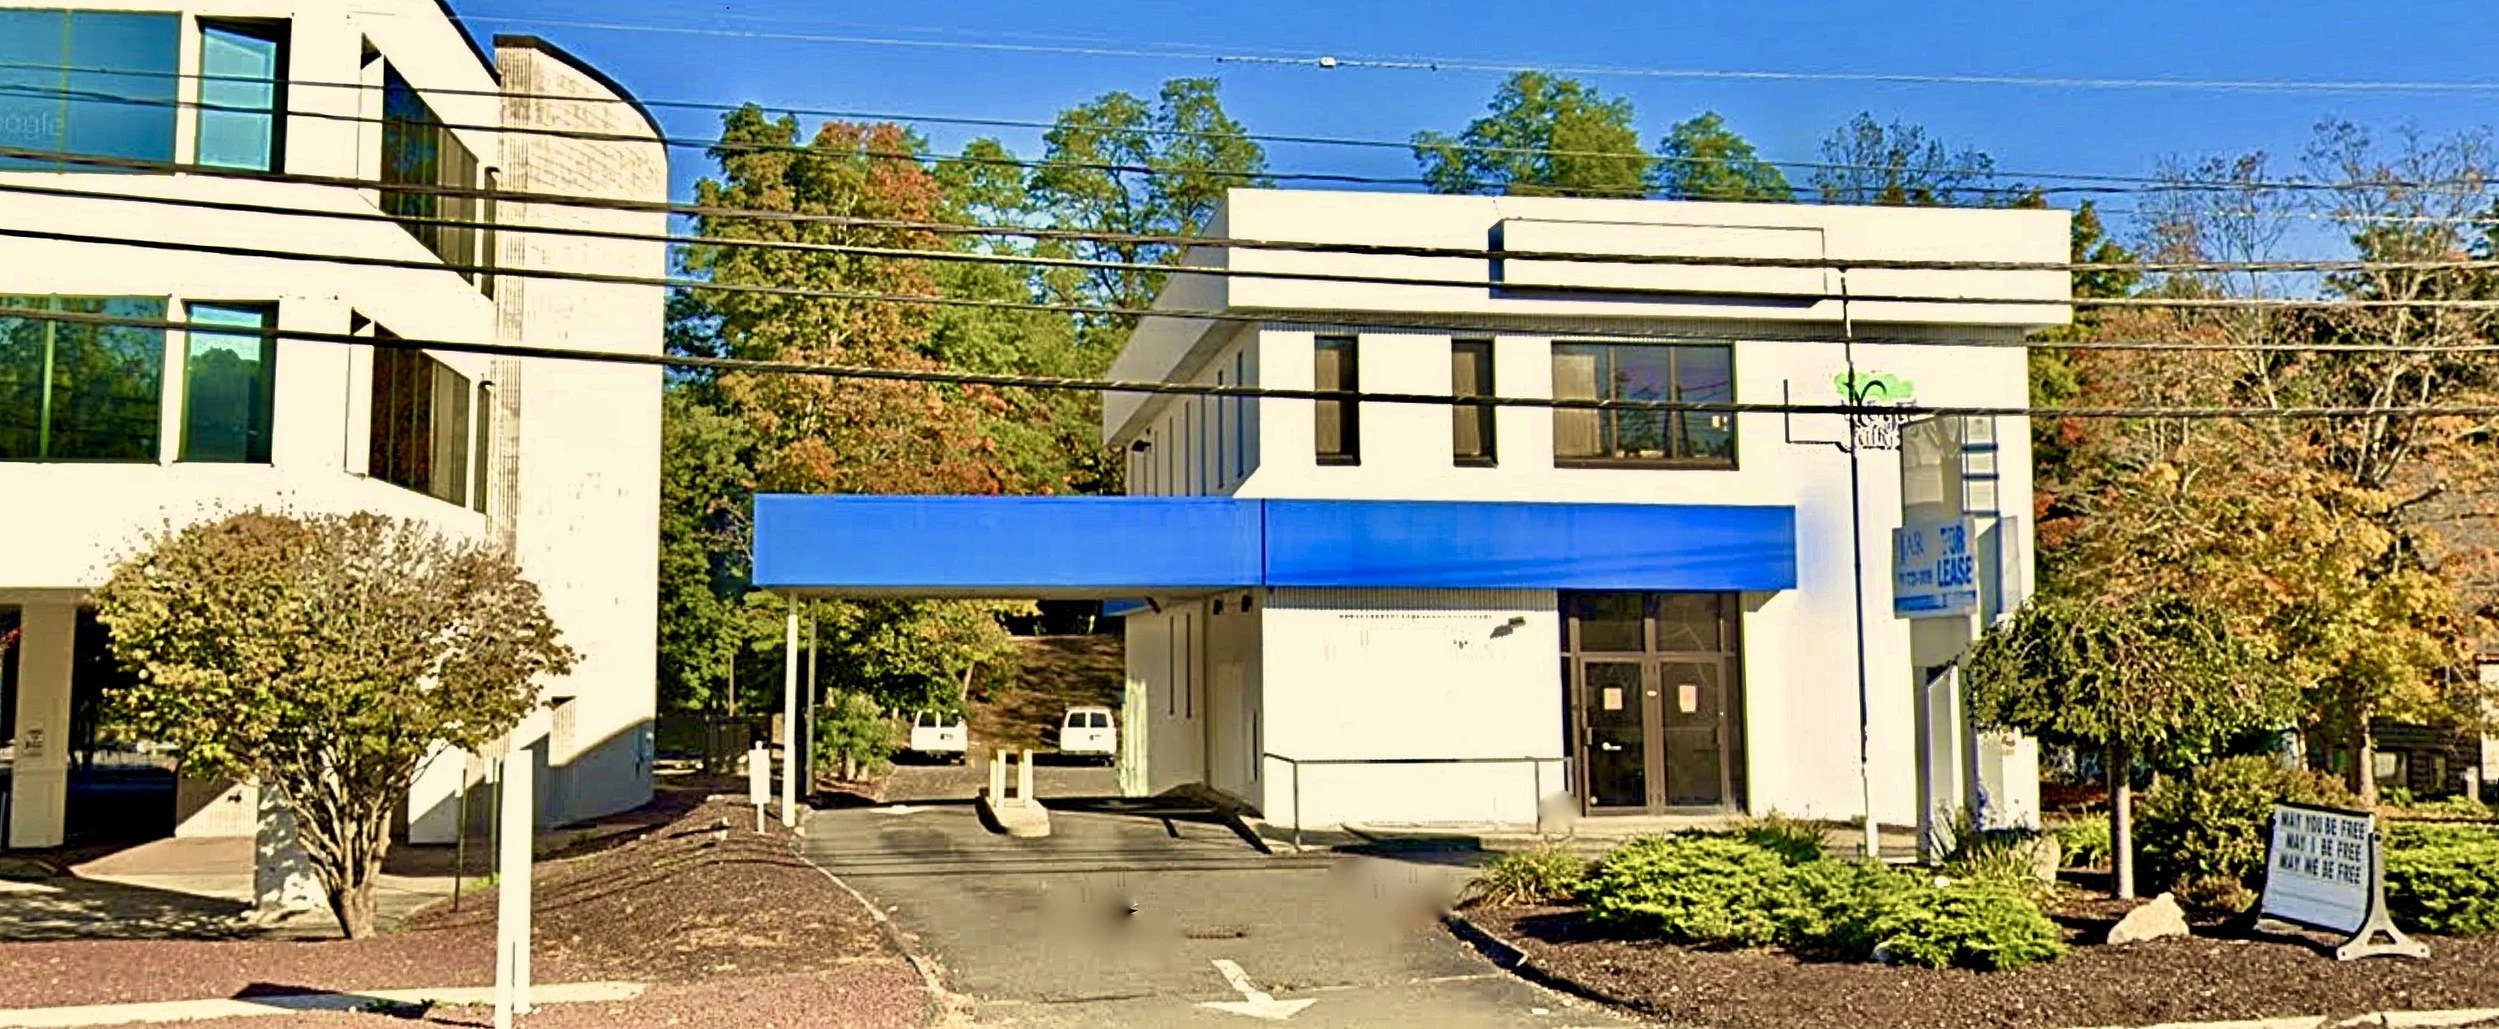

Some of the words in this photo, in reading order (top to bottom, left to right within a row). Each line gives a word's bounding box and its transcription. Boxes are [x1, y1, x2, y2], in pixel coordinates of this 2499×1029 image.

[1937, 555, 1973, 587] LEASE
[2281, 811, 2301, 829] MAY
[2305, 815, 2322, 833] YOU
[2325, 816, 2337, 836] BE
[2341, 819, 2364, 840] FREE
[2286, 832, 2305, 851] MAY
[2321, 838, 2333, 857] BE
[2337, 841, 2361, 862] FREE
[2280, 853, 2300, 872] MAY
[2322, 860, 2334, 879] BE
[2338, 863, 2361, 884] FREE
